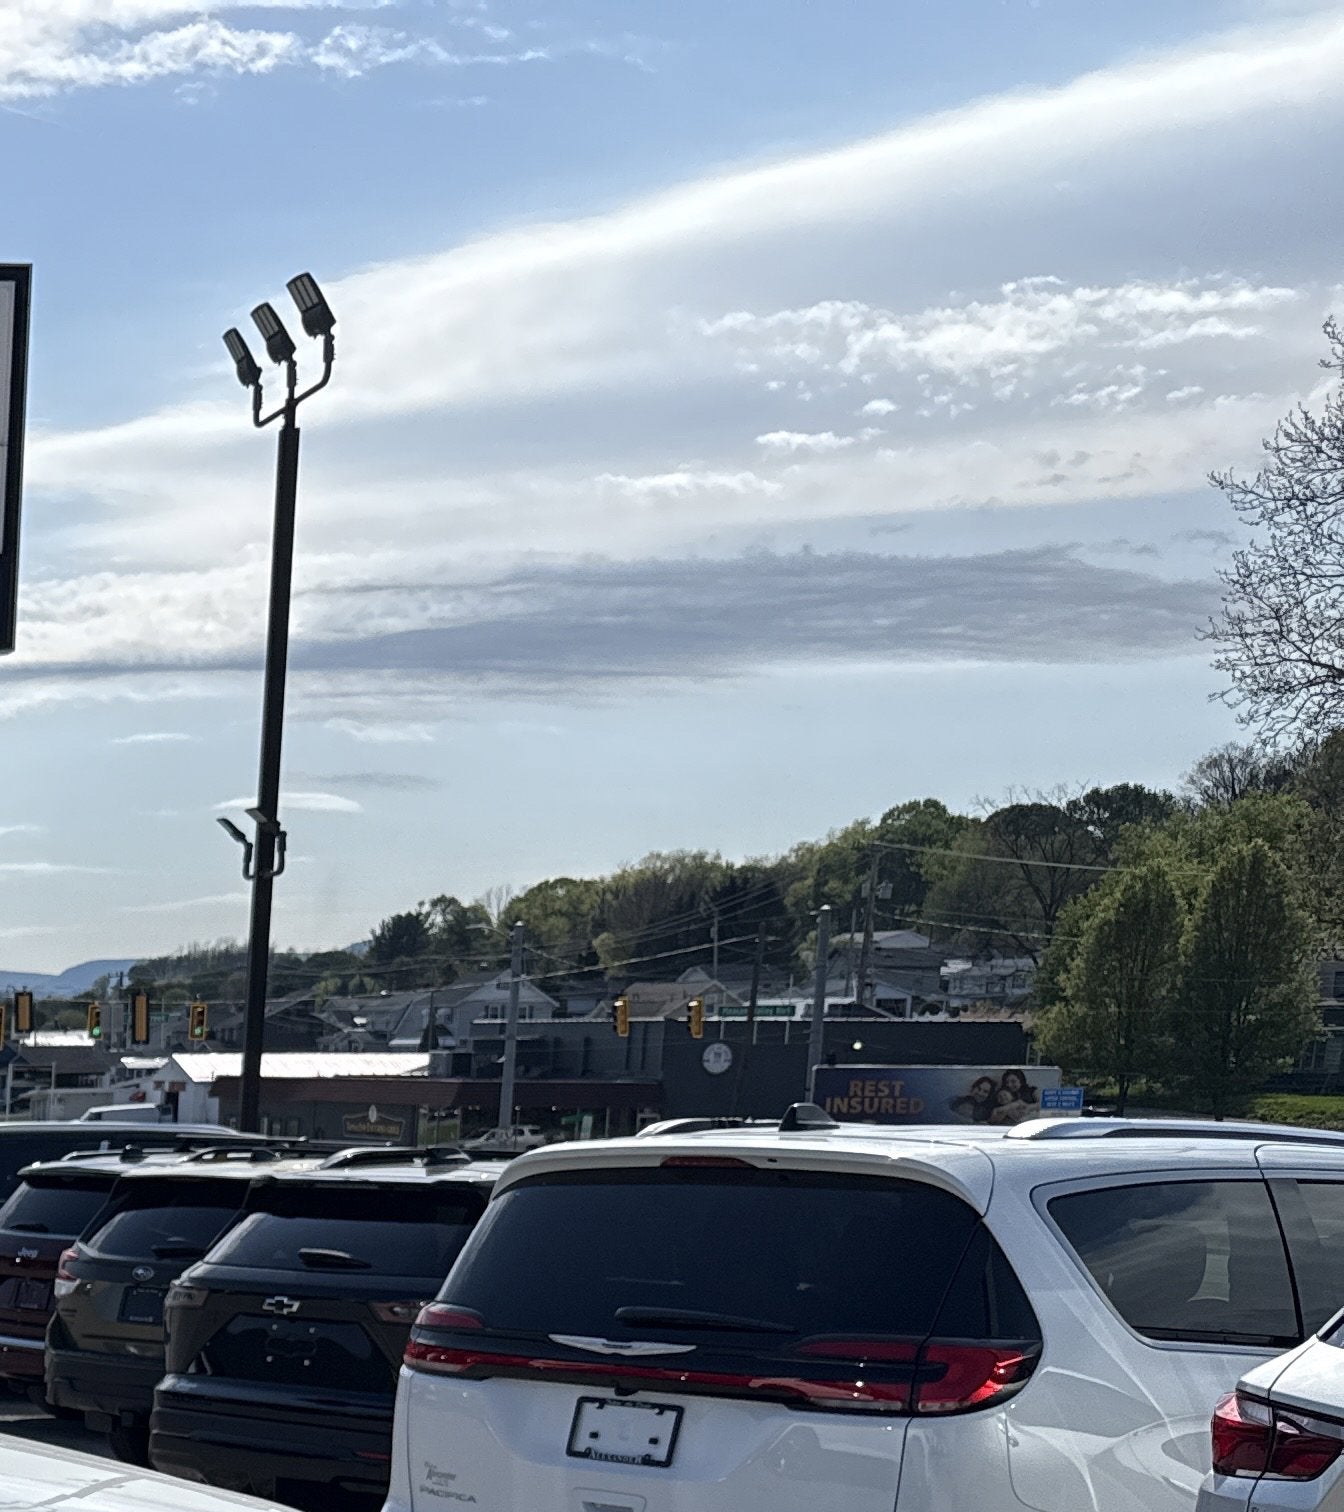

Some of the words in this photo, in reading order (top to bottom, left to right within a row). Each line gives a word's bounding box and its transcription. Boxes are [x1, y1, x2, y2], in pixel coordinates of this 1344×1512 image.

[849, 1080, 905, 1097] REST
[825, 1097, 925, 1115] INSURED
[17, 1246, 40, 1259] Jeep
